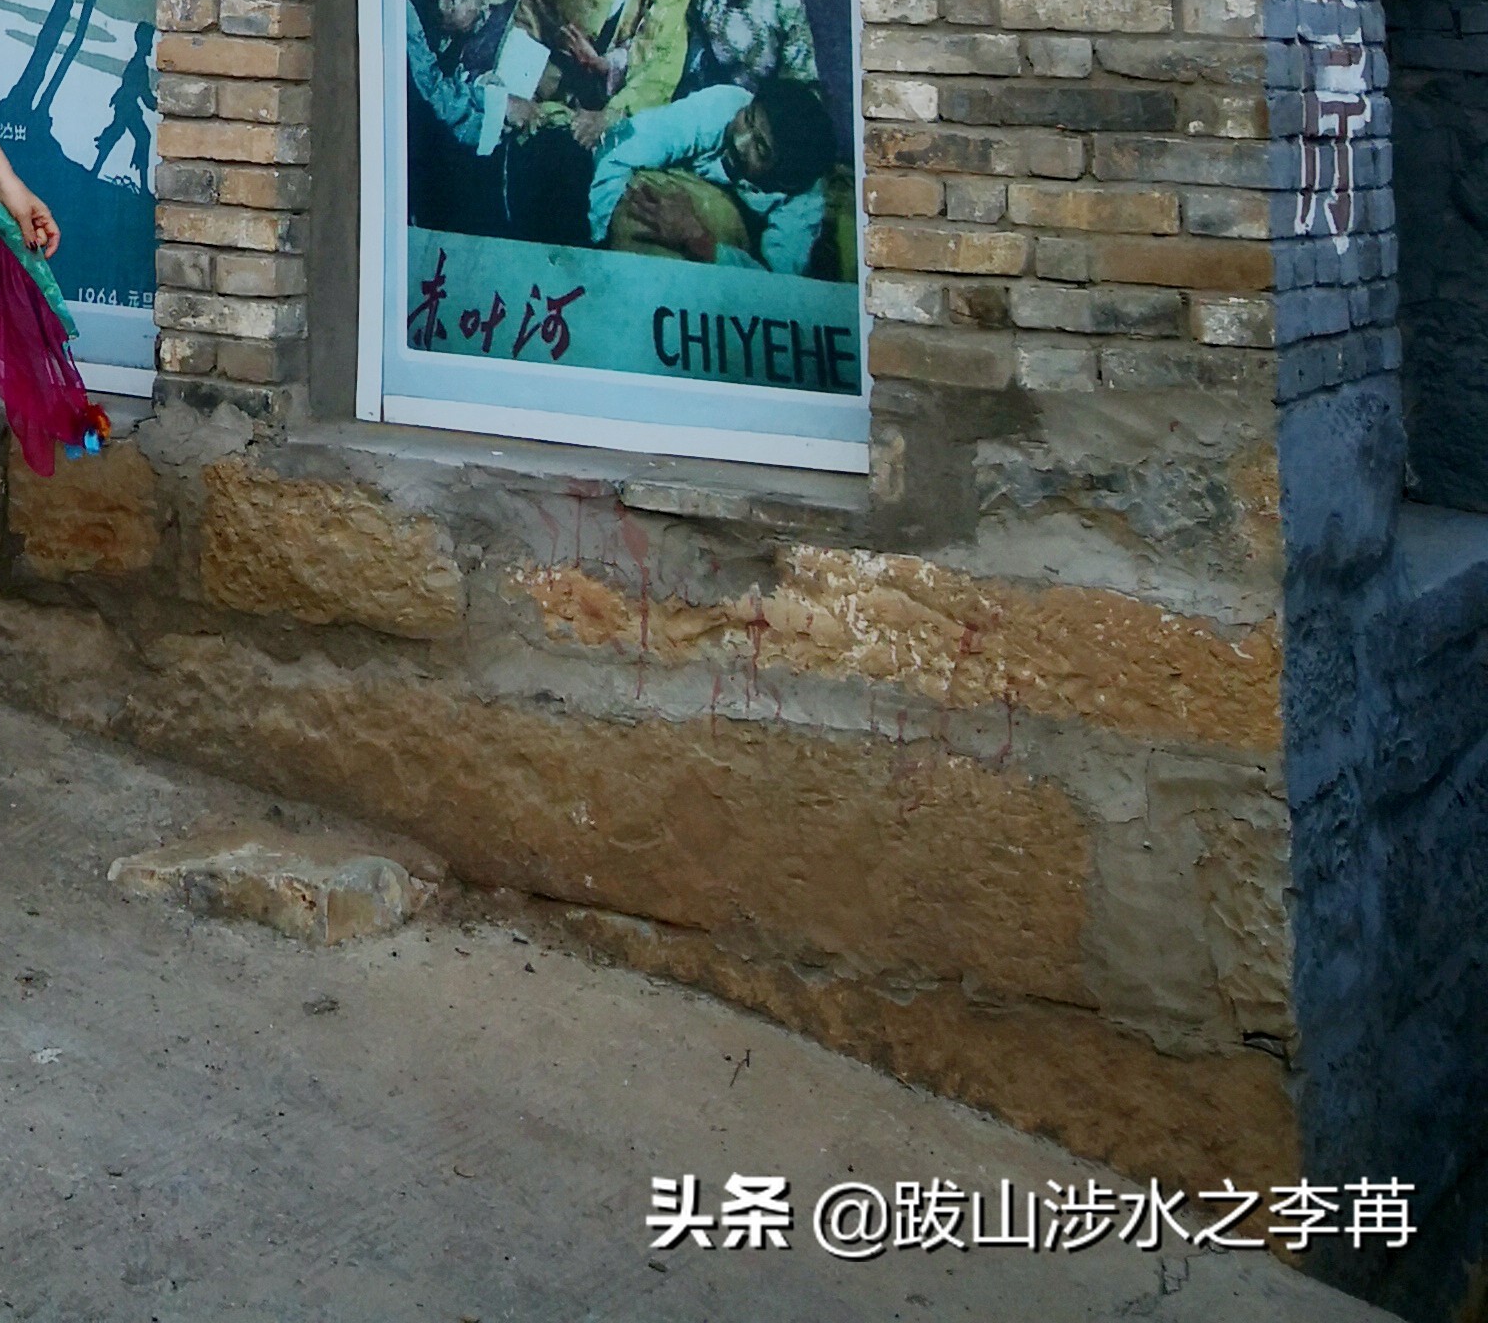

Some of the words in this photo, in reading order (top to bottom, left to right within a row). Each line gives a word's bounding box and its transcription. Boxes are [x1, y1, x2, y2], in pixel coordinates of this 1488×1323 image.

[407, 248, 586, 361] 赤叶河
[652, 305, 858, 391] CHIYEHE
